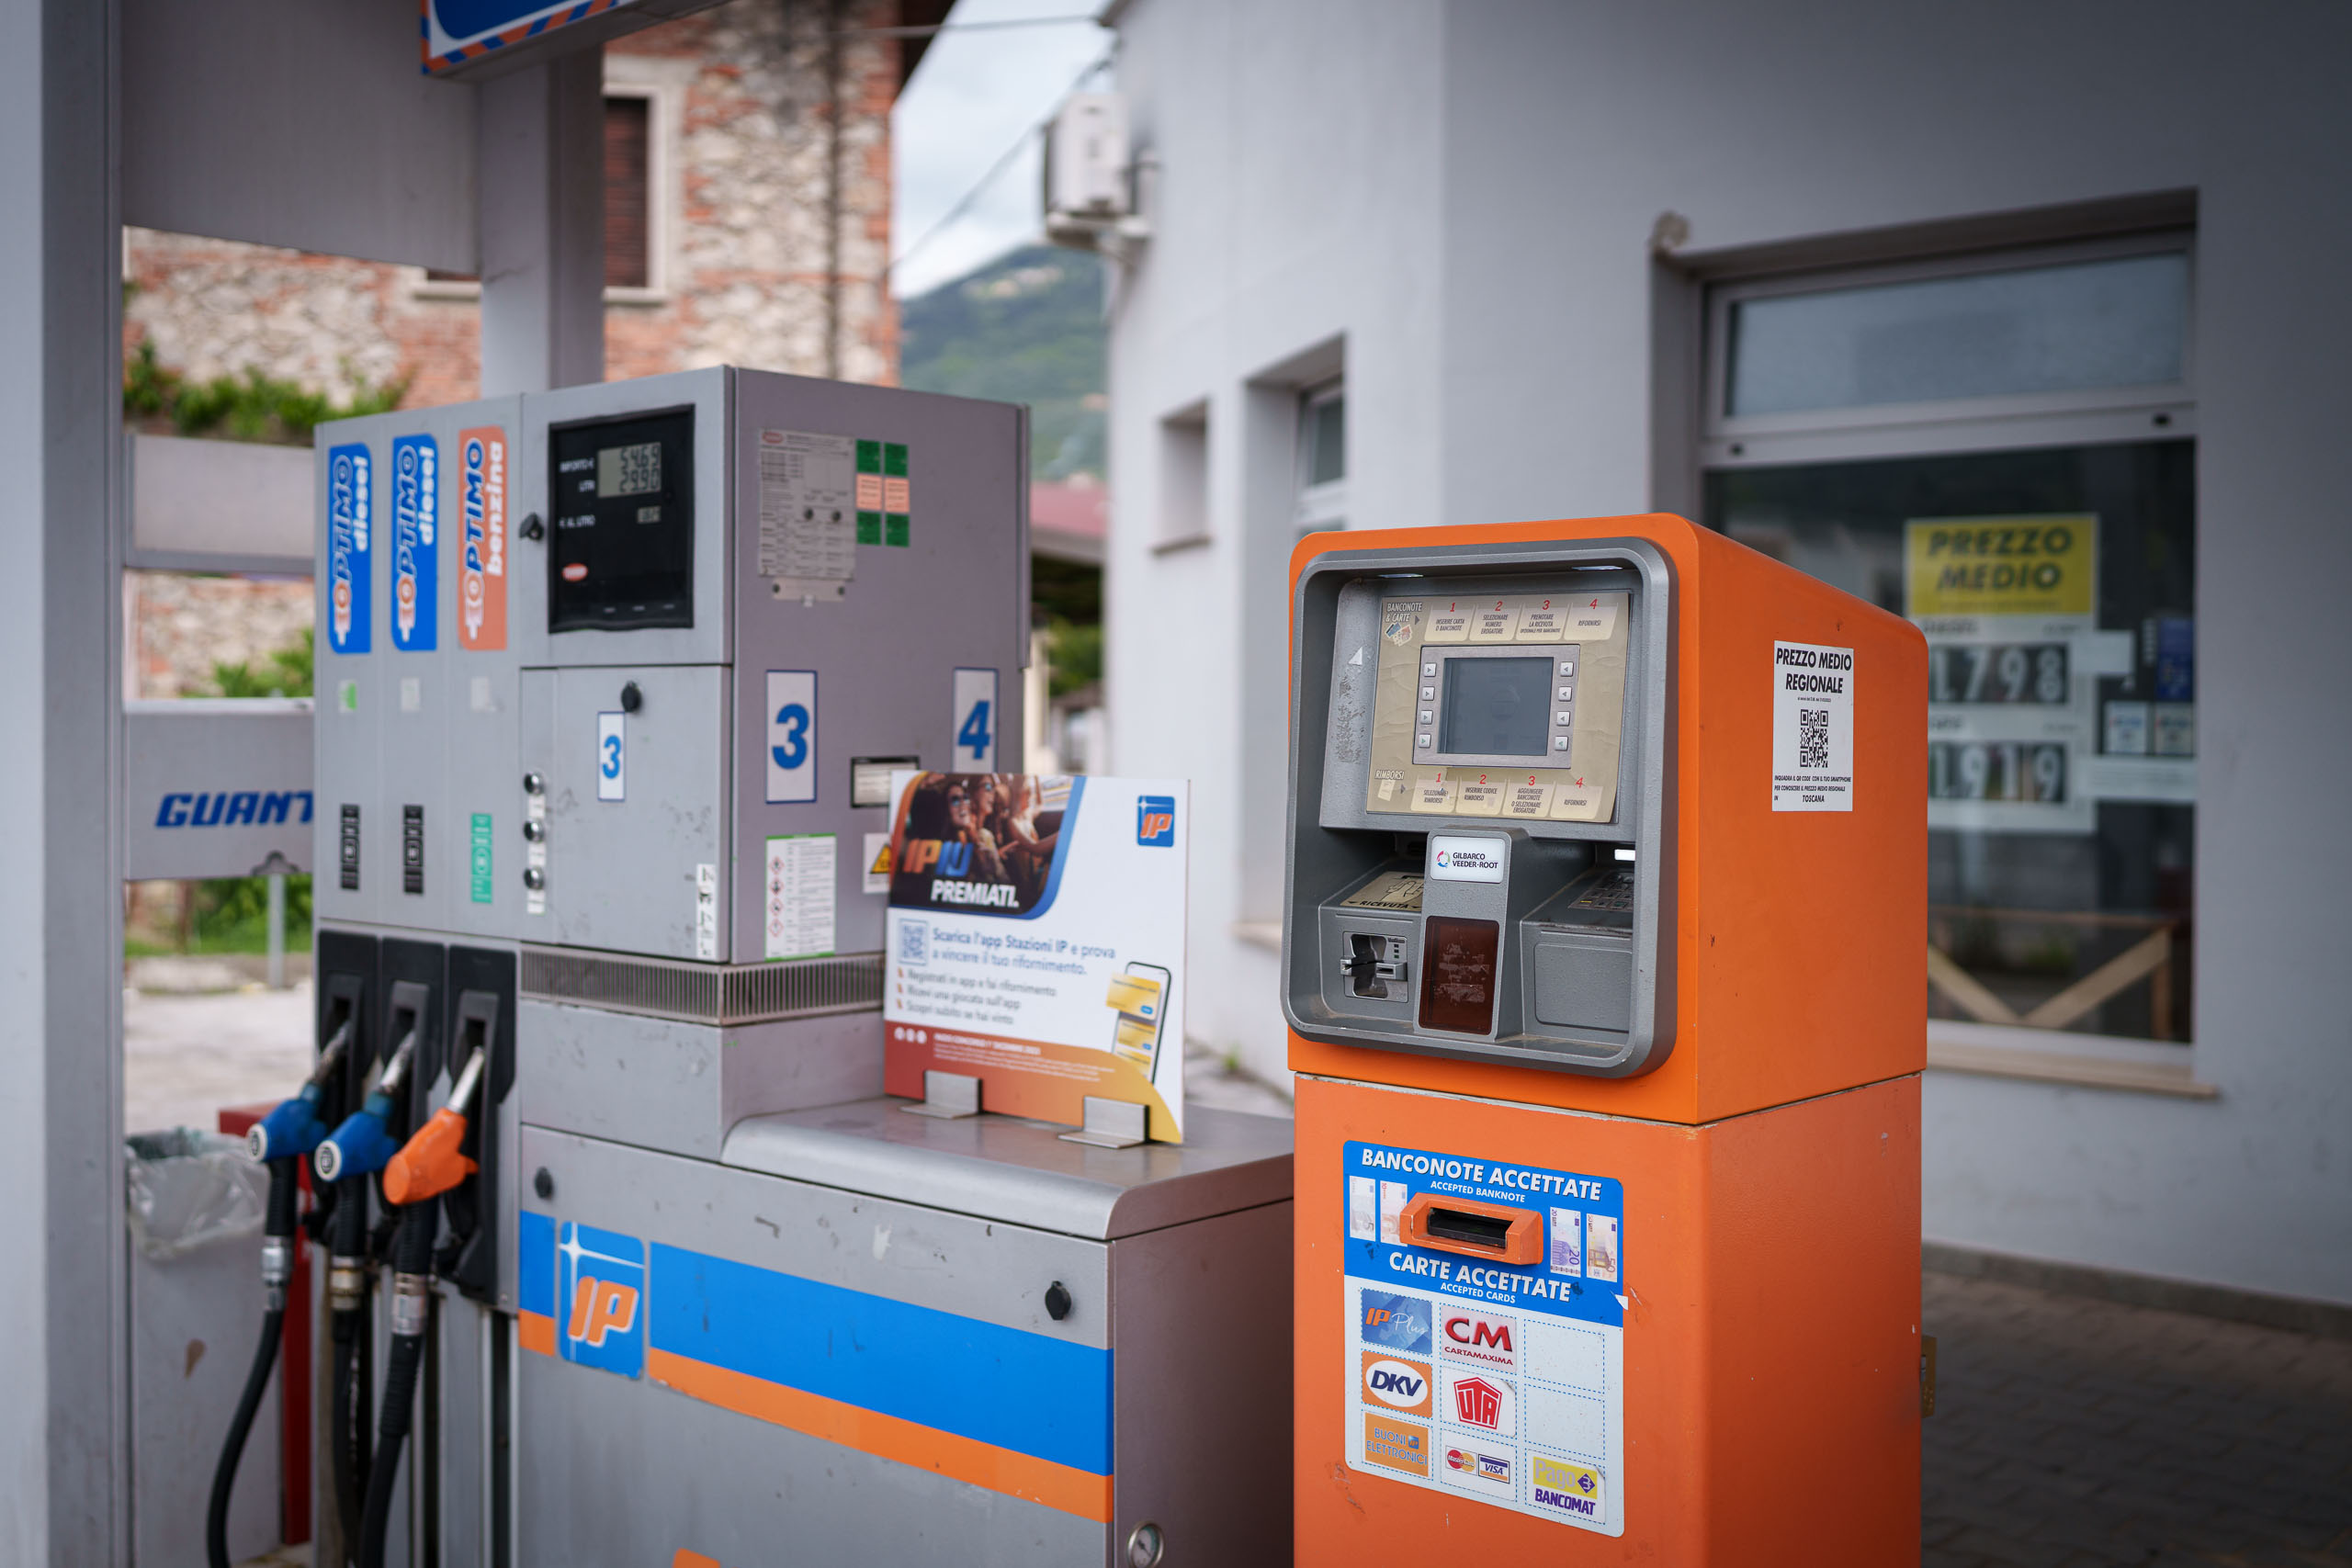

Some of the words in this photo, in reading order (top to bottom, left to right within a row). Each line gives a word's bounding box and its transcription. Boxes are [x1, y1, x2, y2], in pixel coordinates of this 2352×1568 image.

[353, 456, 368, 552] diesel
[419, 446, 434, 546] diesel
[486, 441, 503, 576] benzina
[333, 455, 353, 608] OPTIMO
[397, 445, 418, 609] OPTIMO
[463, 437, 485, 607] OPTIMO
[1928, 526, 2075, 555] PREZZO
[1936, 561, 2063, 592] MEDIO
[1386, 602, 1422, 612] BANCONOTE
[1449, 603, 1456, 612] 1
[1495, 601, 1502, 611] 2
[1542, 600, 1550, 610] 3
[1589, 599, 1598, 609] 4
[1385, 613, 1391, 622] &
[1393, 613, 1410, 623] CARTE
[1776, 648, 1816, 669] PREZZO
[1818, 651, 1852, 671] MEDIO
[1785, 673, 1844, 694] REGIONALE
[772, 703, 810, 770] 3
[956, 700, 991, 761] 4
[602, 735, 622, 779] 3
[1374, 770, 1405, 780] RIMBORSI
[1436, 773, 1441, 783] 1
[1479, 774, 1487, 784] 2
[1529, 775, 1535, 786] 3
[1575, 777, 1584, 788] 4
[154, 790, 314, 828] GUANT
[1139, 813, 1172, 839] IP
[1453, 852, 1486, 860] GILBARCO
[1453, 860, 1498, 869] VEEDER-ROOT
[931, 879, 1020, 908] PREMIATI.
[1360, 900, 1409, 909] RICEVUTA
[933, 928, 971, 944] Scarica
[974, 931, 1002, 949] l'app
[1005, 935, 1052, 953] Stazioni
[1057, 940, 1069, 953] IP
[1070, 944, 1078, 954] e
[1081, 945, 1116, 960] prova
[933, 950, 938, 959] a
[942, 948, 978, 964] vincere
[991, 954, 1009, 967] tuo
[1012, 954, 1087, 976] rifornimento.
[950, 976, 956, 984] in
[959, 977, 976, 989] app
[986, 977, 996, 989] fai
[1000, 981, 1057, 997] rifornimento
[934, 991, 949, 999] una
[952, 991, 983, 1004] giocata
[987, 995, 1021, 1011] sull'app
[936, 1006, 962, 1018] subito
[976, 1011, 988, 1021] hai
[991, 1013, 1013, 1024] vinto
[1361, 1148, 1485, 1182] BANCONOTE
[1488, 1168, 1602, 1201] ACCETTATE
[1430, 1180, 1475, 1195] ACCEPTED
[1476, 1187, 1526, 1203] BANKNOTE
[1568, 1249, 1579, 1266] 20
[1606, 1258, 1616, 1273] 50
[1388, 1252, 1450, 1280] CARTE
[1455, 1265, 1571, 1303] ACCETTATE
[1440, 1282, 1484, 1296] ACCEPTED
[1486, 1292, 1516, 1304] CARDS
[568, 1275, 639, 1347] IP
[1365, 1307, 1391, 1326] IP
[1444, 1316, 1513, 1352] CM
[1444, 1346, 1513, 1366] CARTAMAXIMA
[1371, 1370, 1422, 1397] DKV
[1456, 1380, 1500, 1427] UTA
[1374, 1427, 1406, 1445] BUONI
[1366, 1440, 1428, 1465] ELETTRONICI
[1448, 1455, 1475, 1468] MasterCard
[1485, 1463, 1503, 1475] VISA
[1535, 1459, 1576, 1489] Pago
[1535, 1488, 1596, 1516] BANCOMAT
